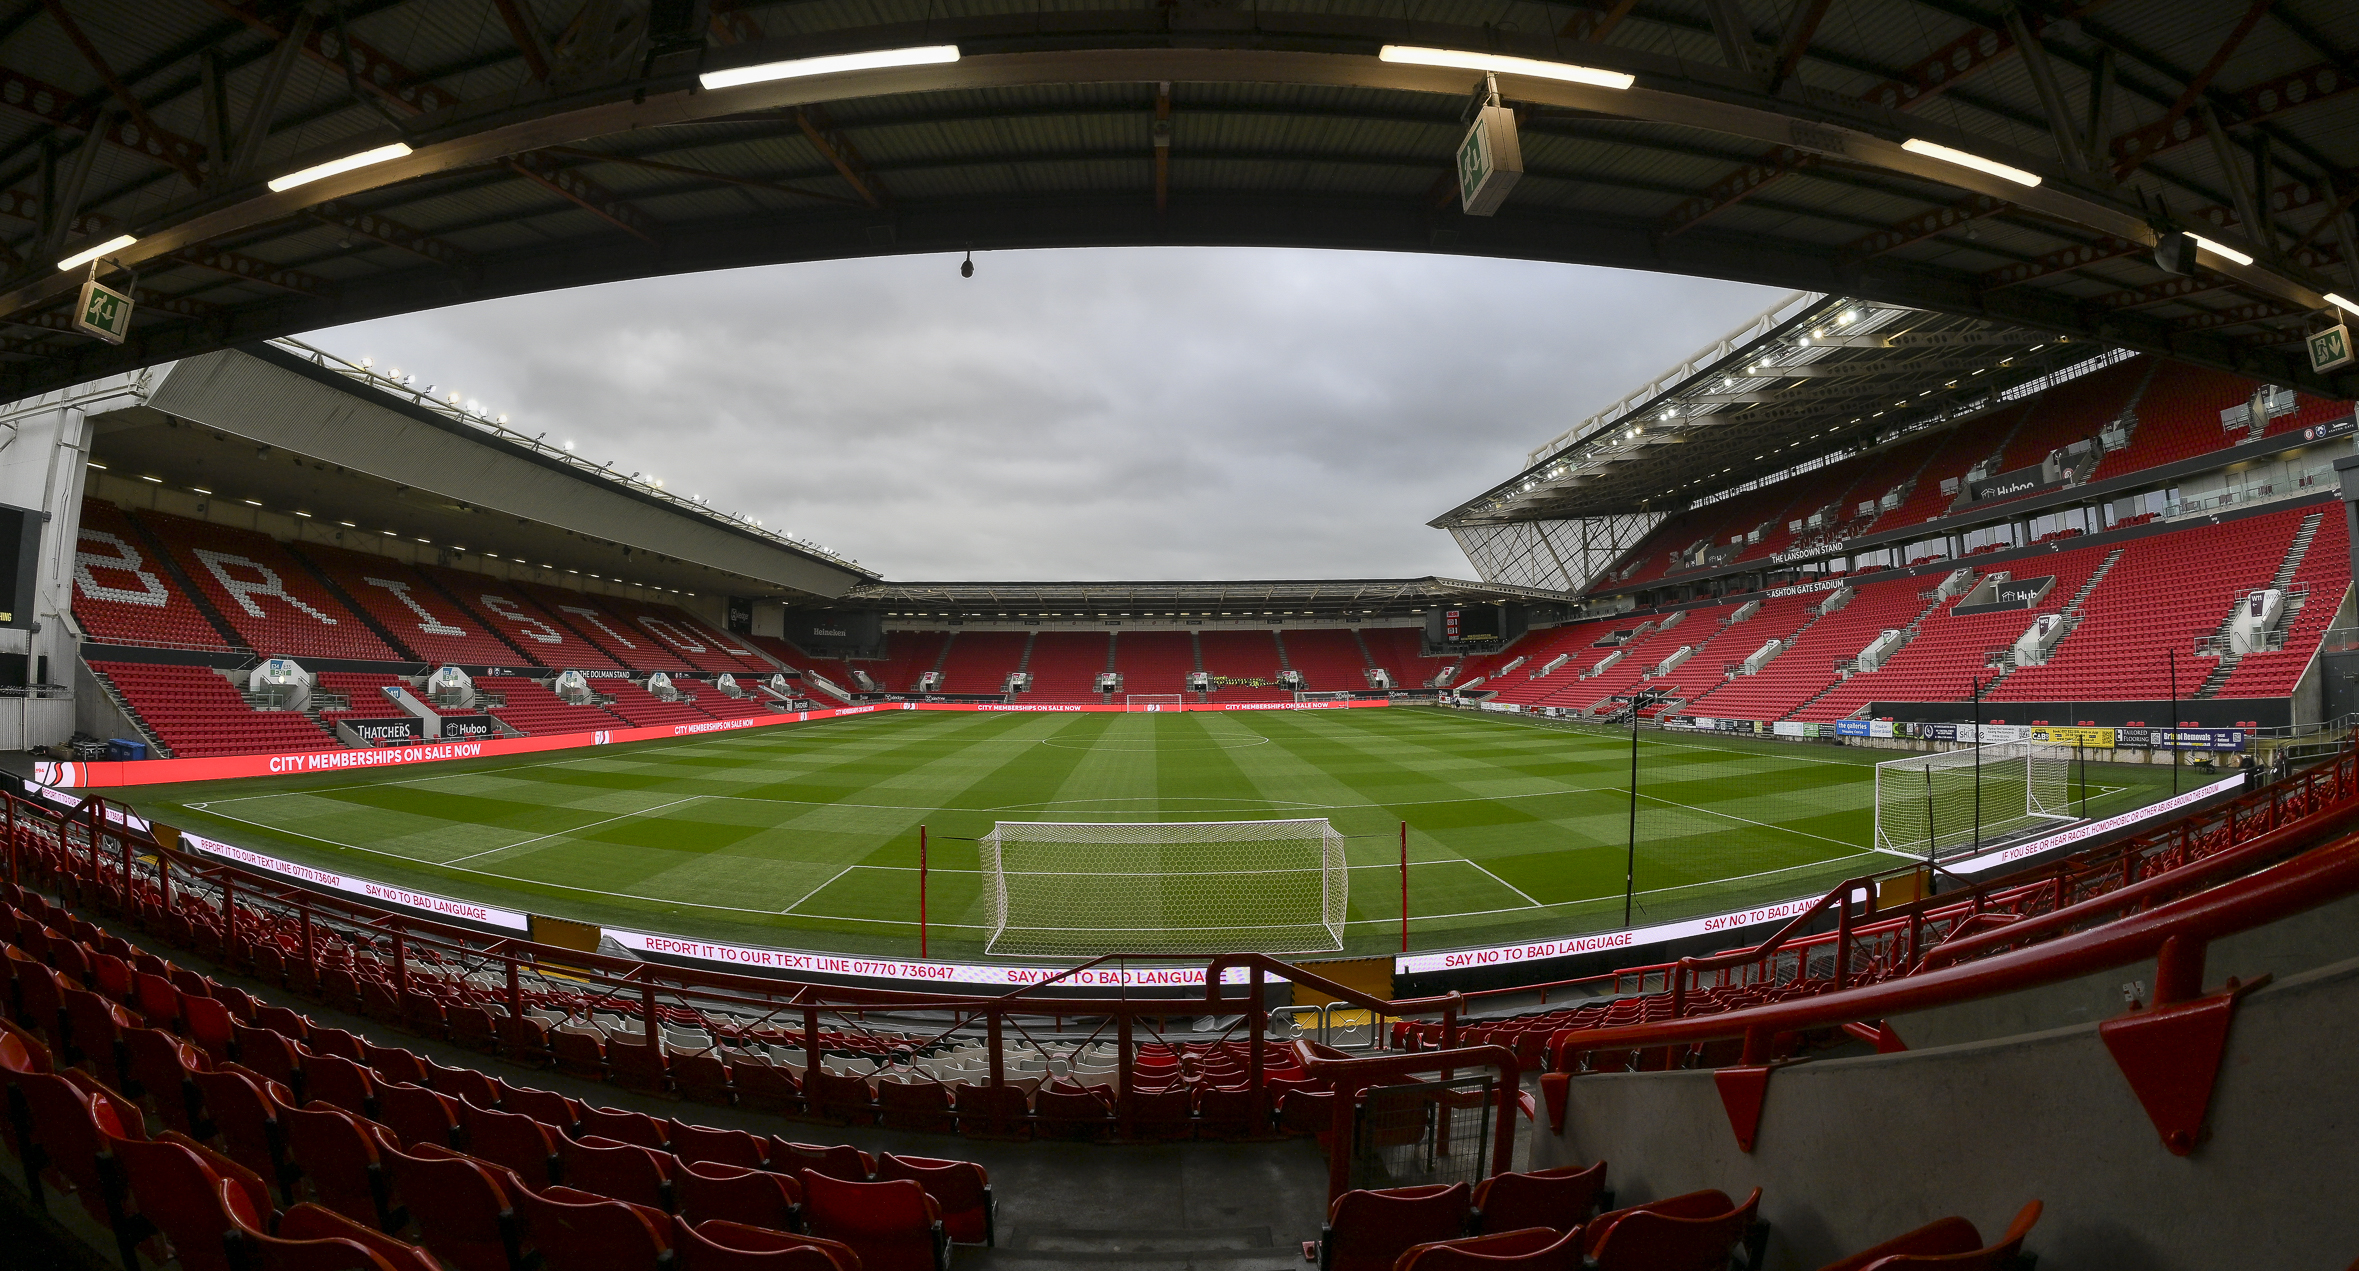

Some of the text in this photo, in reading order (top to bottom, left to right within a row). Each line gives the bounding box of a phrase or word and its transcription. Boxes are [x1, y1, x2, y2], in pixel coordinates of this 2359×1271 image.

[1772, 542, 1843, 564] THE LANSDOWN STAND
[1771, 579, 1844, 598] ASHTON GATE STADIUM
[813, 627, 846, 637] Heineken
[580, 670, 590, 679] THE
[590, 671, 613, 679] DOLMAN
[613, 671, 631, 680] STAND
[357, 724, 411, 739] THATCHERS
[459, 723, 487, 735] Huboo
[674, 718, 754, 735] CITY MEMBERSHIPS ON SALE NOW
[1847, 723, 1868, 731] galleries
[2183, 733, 2211, 741] Removals
[269, 743, 482, 772] CITY MEMBERSHIPS ON SALE NOW
[2001, 850, 2009, 862] IF
[2009, 846, 2024, 860] YOU
[2025, 843, 2038, 855] SEE
[2039, 840, 2049, 851] OR
[2050, 834, 2067, 848] HEAR
[2067, 827, 2092, 843] RACIST,
[2092, 814, 2131, 834] HOMOPHOBIC
[2139, 806, 2157, 819] OTHER
[2157, 800, 2174, 814] ABUSE
[2173, 794, 2192, 809] AROUND
[2200, 783, 2219, 800] STADIUM
[200, 839, 225, 855] REPORT
[232, 847, 242, 860] TO
[242, 849, 257, 863] OUR
[257, 853, 275, 868] TEXT
[275, 859, 292, 875] LINE
[293, 865, 313, 880] 07770
[314, 870, 341, 887] 736047
[365, 883, 487, 922] SAY NO TO BAD LANGUAGE
[1703, 916, 1727, 932] SAY
[1728, 913, 1747, 928] NO
[1749, 910, 1765, 924] TO
[1767, 905, 1791, 921] BAD
[645, 936, 954, 980] REPORT IT TO OUR TEXT LINE 07770 736047
[1445, 932, 1633, 969] SAY NO TO BAD LANGUAGE
[1007, 970, 1227, 984] SAY NO TO BAD LANGUAE
